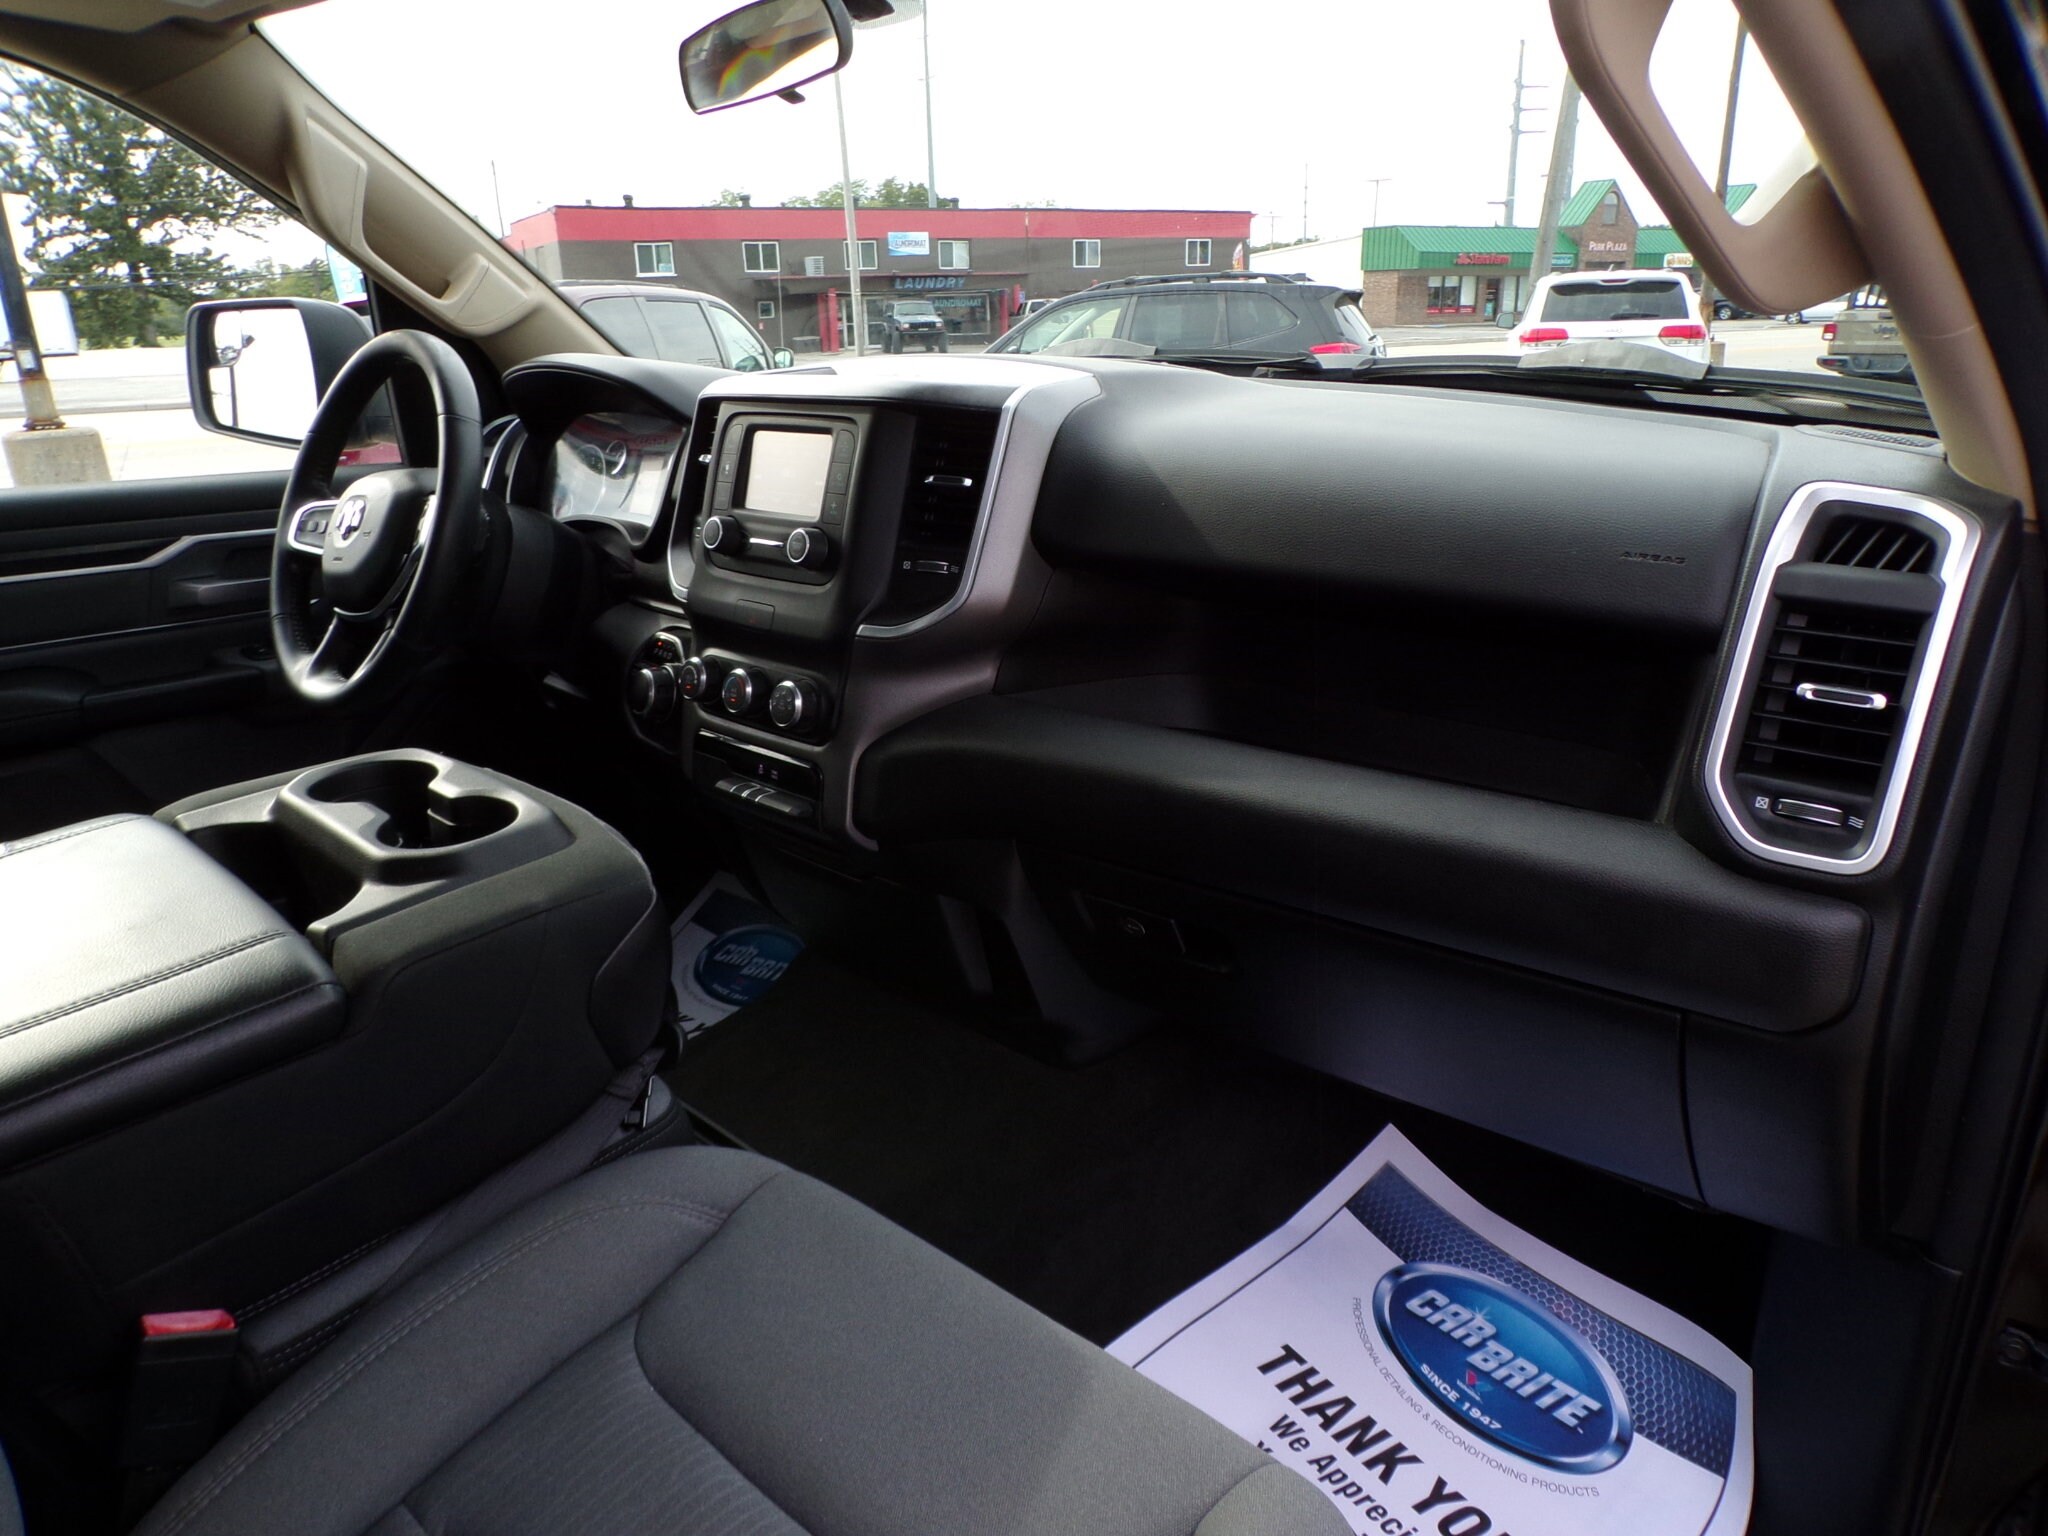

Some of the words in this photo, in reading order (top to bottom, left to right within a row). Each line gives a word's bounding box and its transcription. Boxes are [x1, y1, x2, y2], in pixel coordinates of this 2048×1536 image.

[1606, 241, 1627, 251] PLAZA
[894, 277, 965, 289] LAUNDRY
[934, 298, 982, 307] AUNDROMAT
[1620, 551, 1686, 565] AIRBAG
[713, 944, 758, 966] CAR
[739, 957, 789, 981] BRIT
[1405, 1289, 1497, 1348] CAR
[1466, 1339, 1603, 1428] BRITE
[1353, 1297, 1381, 1368] PROFESSIONAL
[1379, 1367, 1423, 1414] DETAILING
[1422, 1413, 1431, 1421] &
[1431, 1420, 1528, 1484] RECONDITIONING
[1531, 1477, 1600, 1497] PRODUCTS
[1420, 1363, 1461, 1402] SINCE
[1461, 1402, 1502, 1430] 1947
[1257, 1344, 1425, 1486] THANK
[1411, 1475, 1511, 1536] YO
[1269, 1414, 1311, 1452] We
[1307, 1454, 1419, 1536] Appreci
